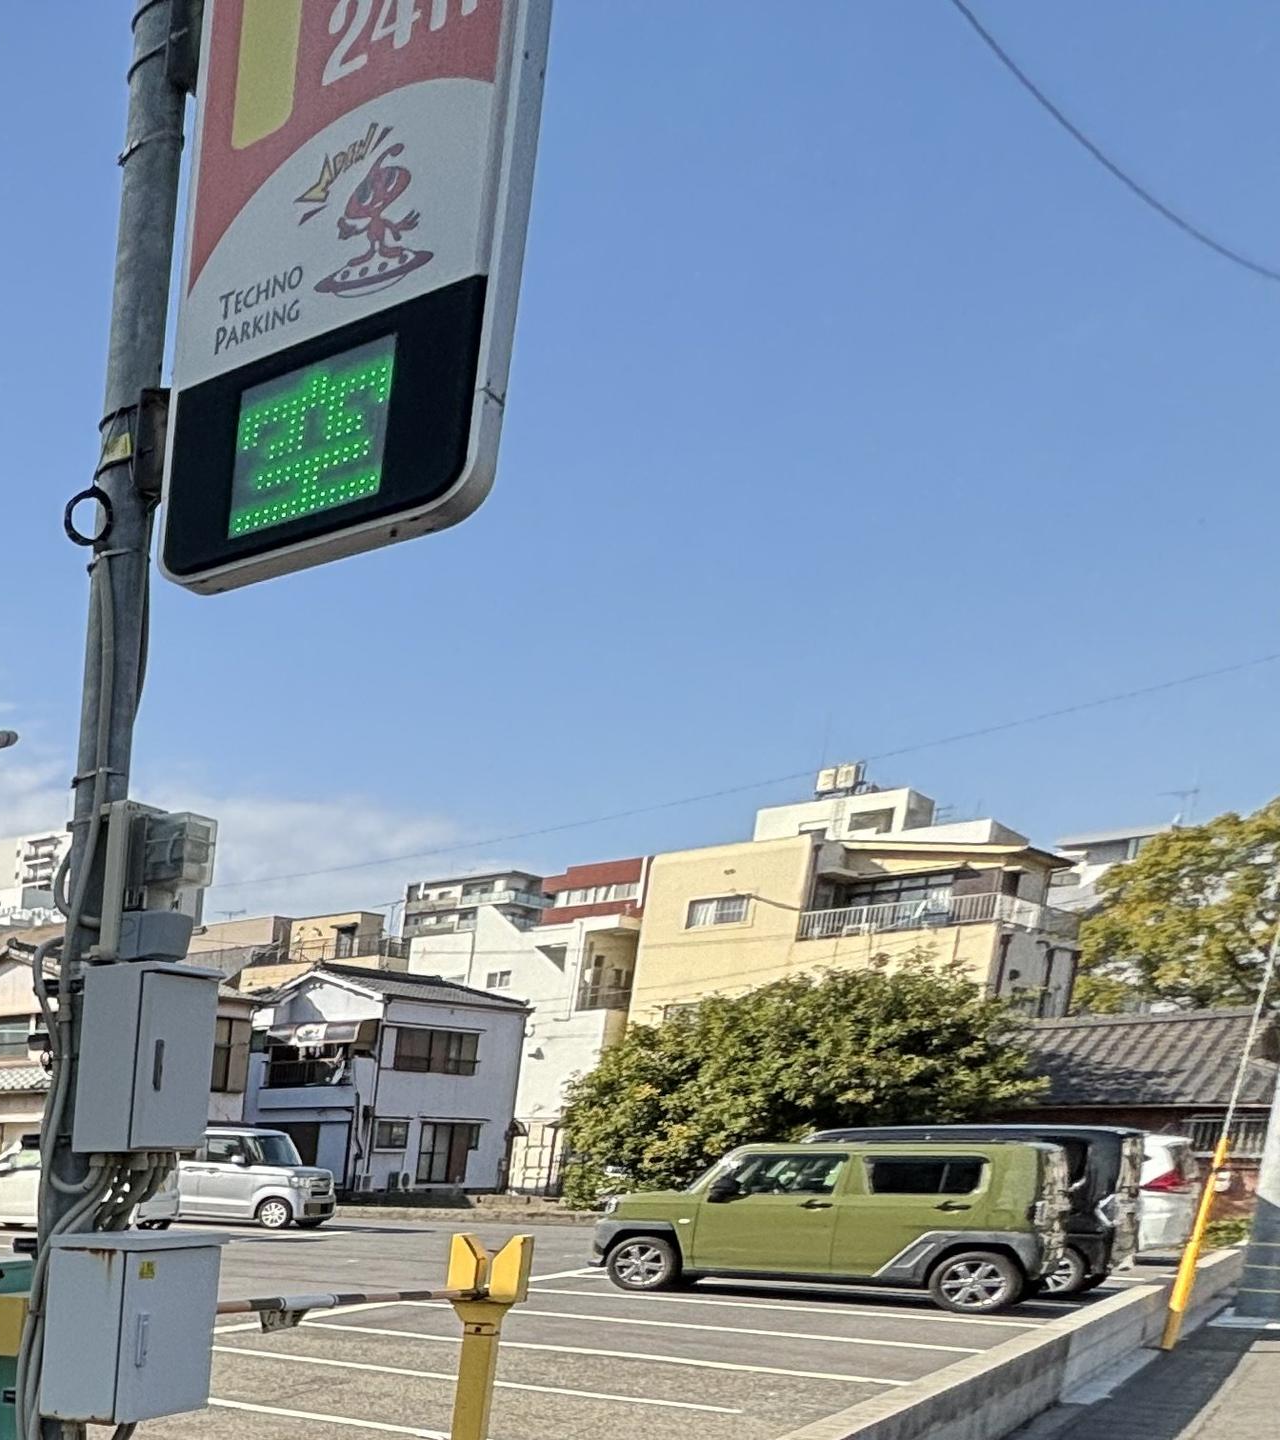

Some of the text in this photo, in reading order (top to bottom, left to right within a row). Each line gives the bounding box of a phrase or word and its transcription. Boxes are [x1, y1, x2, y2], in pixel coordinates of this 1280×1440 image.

[218, 266, 304, 321] TECHNO
[213, 300, 301, 355] PARKING
[233, 366, 388, 536] 空
